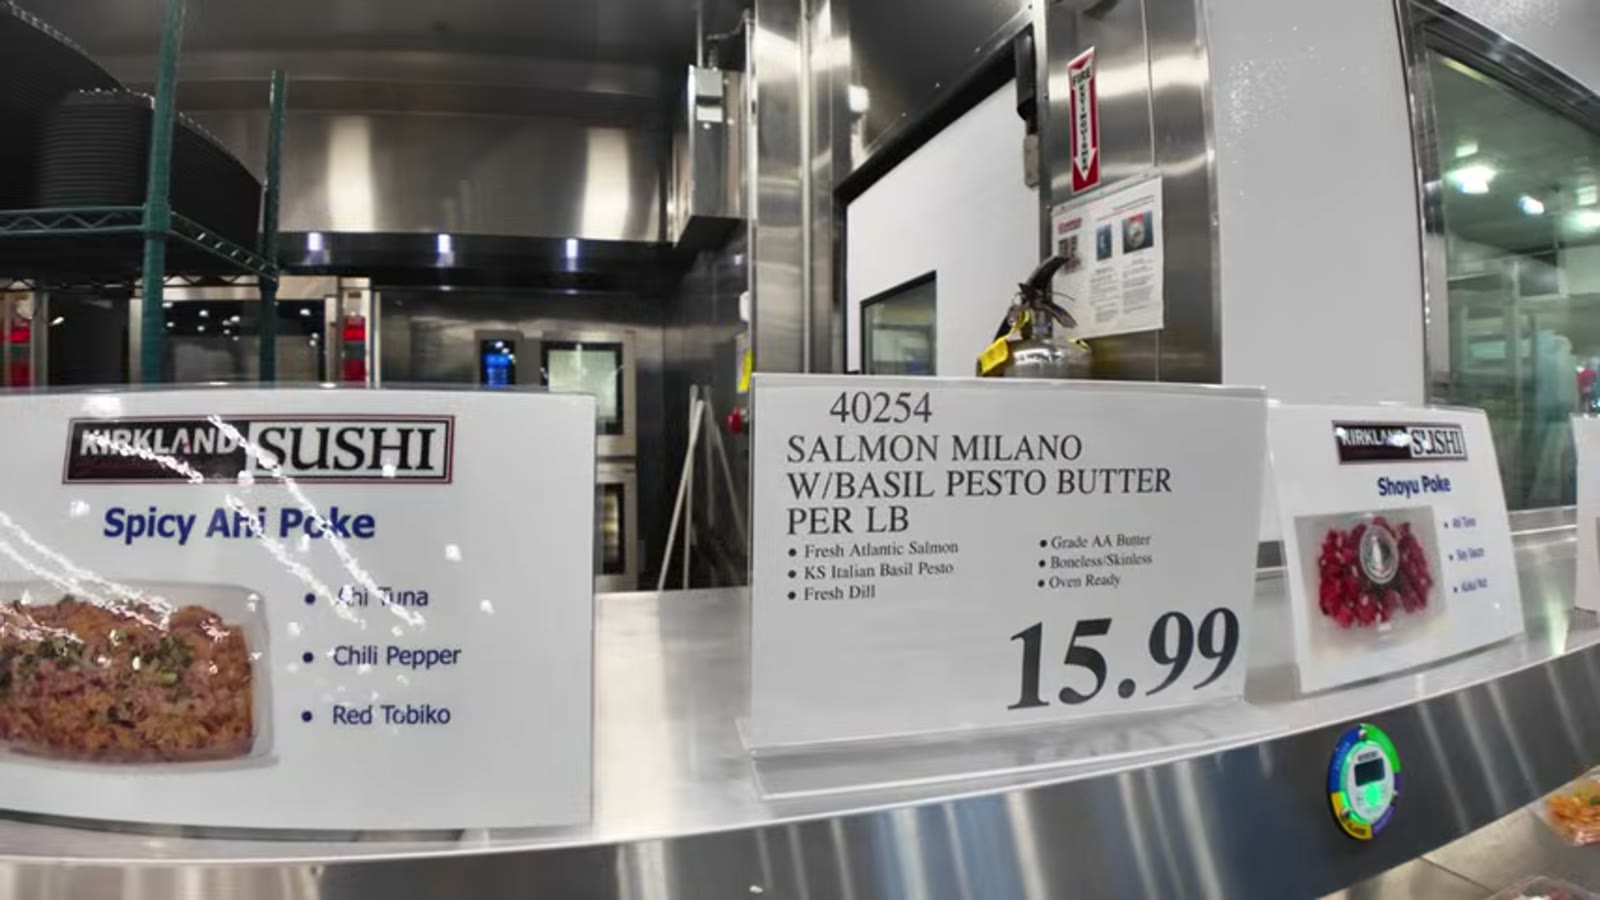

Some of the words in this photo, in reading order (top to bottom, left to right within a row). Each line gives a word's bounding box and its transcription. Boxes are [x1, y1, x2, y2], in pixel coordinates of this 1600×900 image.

[1072, 67, 1091, 88] FIRE
[829, 391, 932, 424] 40254
[1341, 428, 1409, 446] KIRKLA
[80, 428, 240, 456] KIRKLAND
[256, 427, 436, 471] SUSHI
[787, 434, 939, 464] SALMON
[951, 434, 1082, 461] MILANO
[787, 470, 935, 500] W/BASIL
[946, 469, 1046, 497] PESTO
[1057, 468, 1172, 494] BUTTER
[1377, 477, 1419, 498] Shoyu
[1421, 475, 1451, 493] Poke
[104, 507, 196, 545] Spicy
[206, 507, 266, 538] Ahi
[280, 506, 375, 539] Poke
[787, 508, 854, 535] PER
[866, 506, 909, 533] LB
[805, 545, 844, 558] Fresh
[850, 543, 904, 557] Atlantic
[908, 541, 958, 555] Salmon
[1051, 536, 1088, 549] Grade
[1092, 535, 1112, 547] AA
[1116, 533, 1151, 546] Butter
[805, 566, 826, 580] KS
[831, 564, 875, 579] Italian
[880, 562, 913, 577] Basil
[918, 561, 954, 575] Pesto
[1049, 576, 1082, 589] Oven
[1086, 573, 1120, 589] Ready
[378, 587, 428, 606] Tuna
[804, 587, 844, 600] Fresh
[849, 585, 875, 599] Dill
[333, 645, 378, 666] Chili
[386, 645, 461, 669] Pepper
[1007, 607, 1239, 710] 15.99
[333, 705, 372, 724] Red
[380, 704, 451, 724] Tobiko
